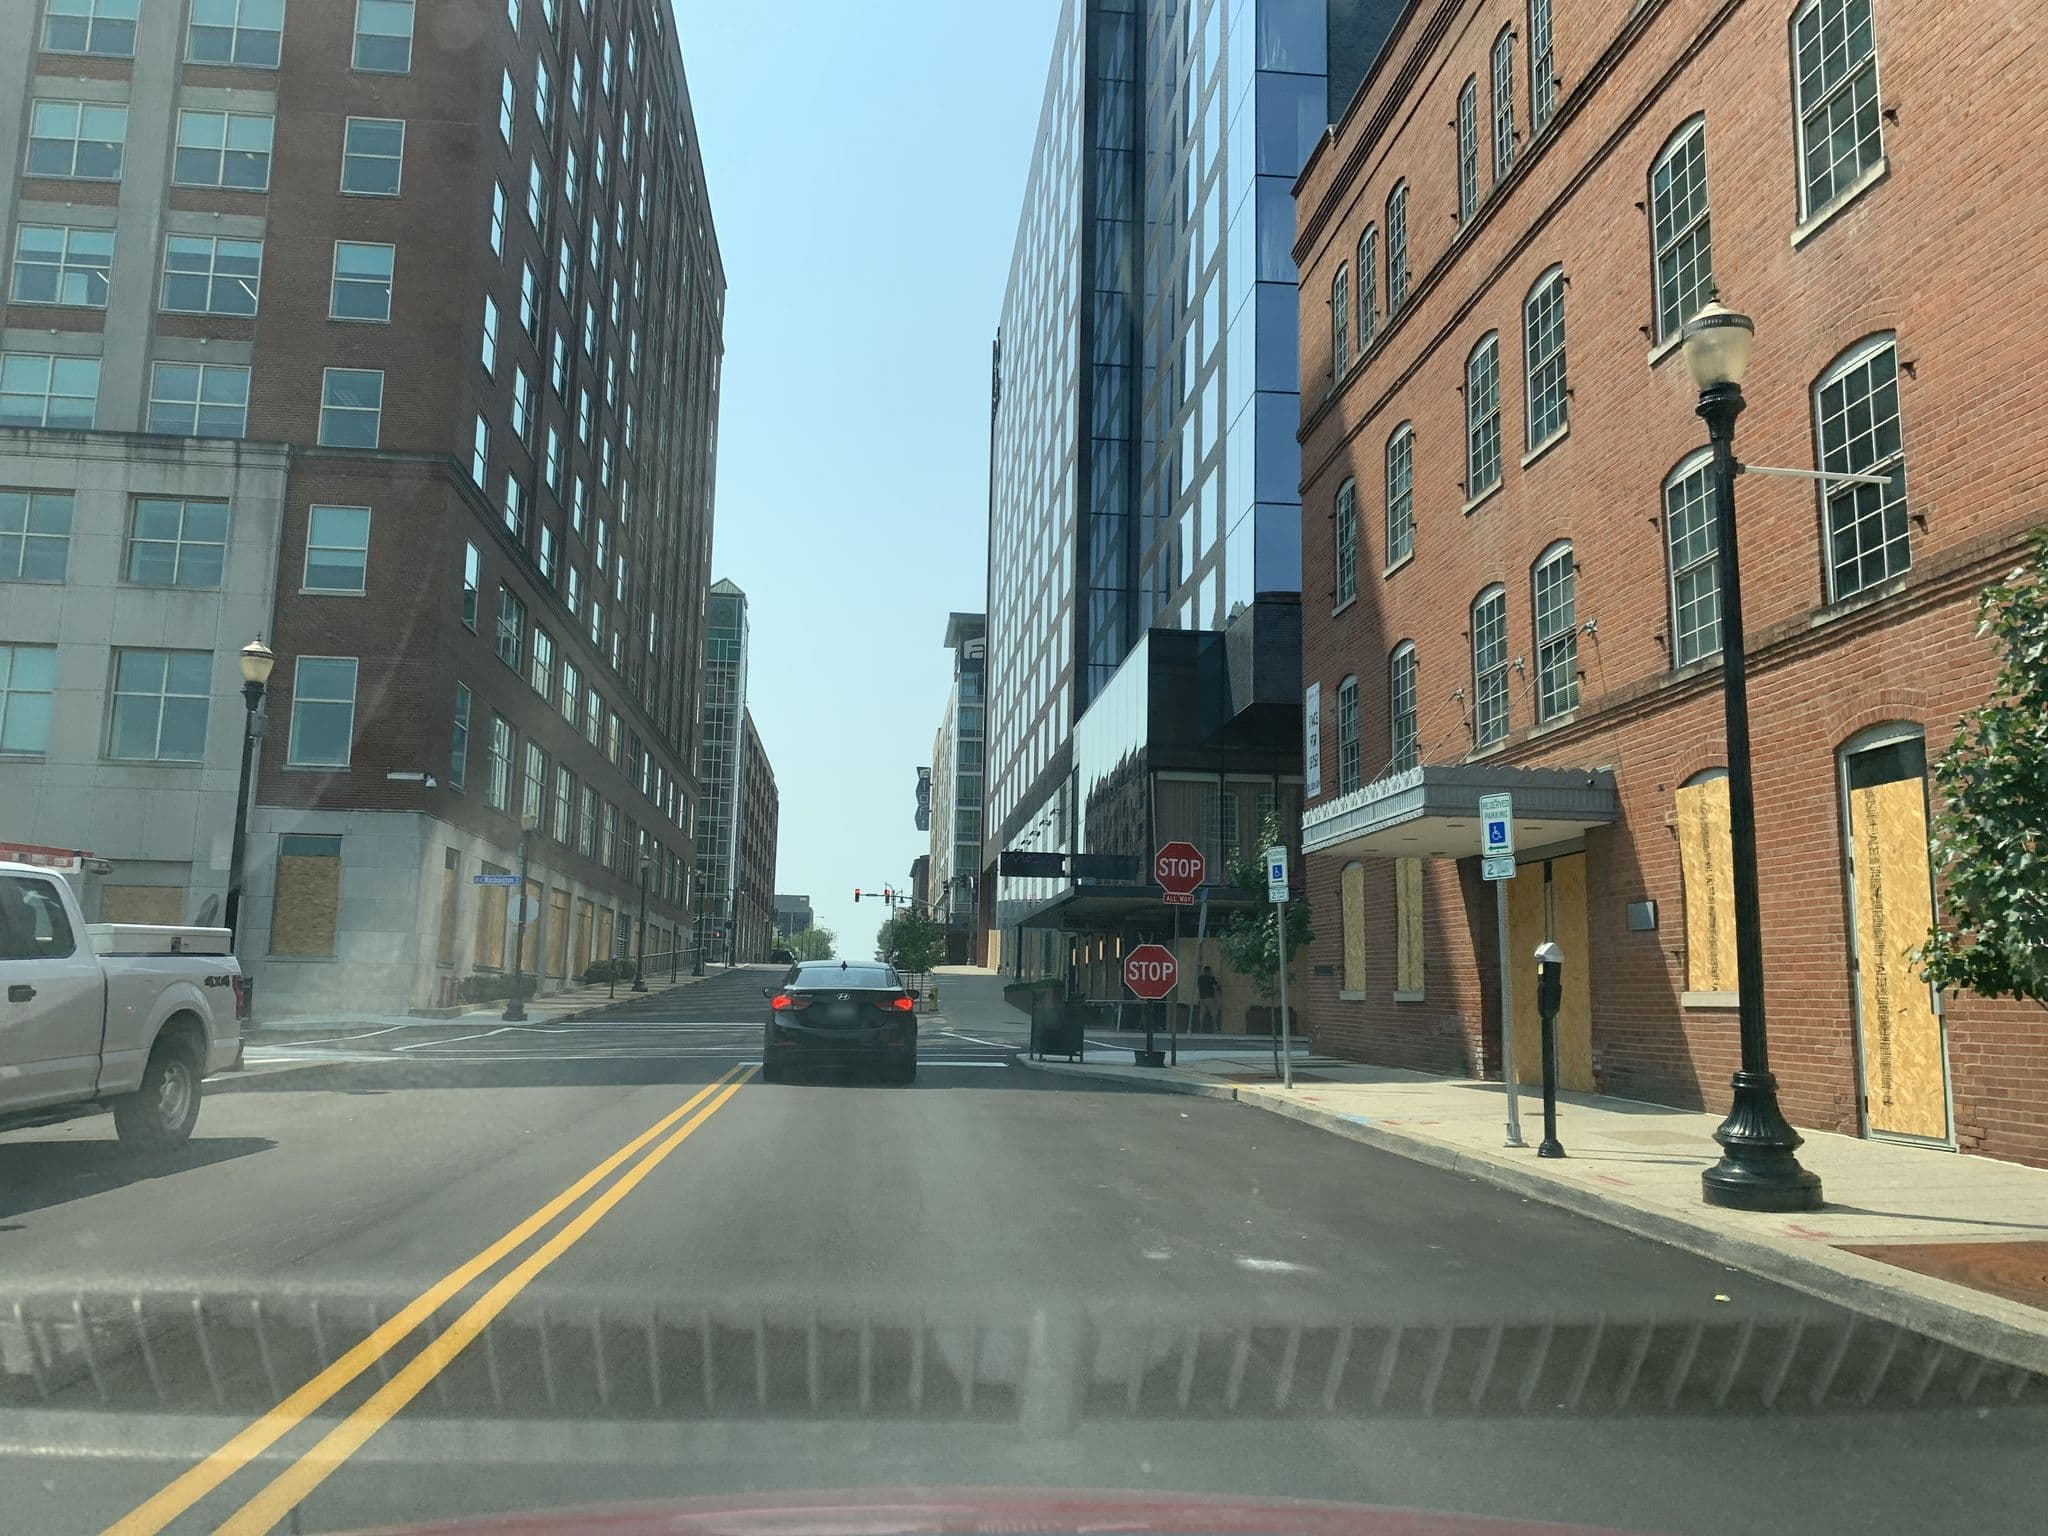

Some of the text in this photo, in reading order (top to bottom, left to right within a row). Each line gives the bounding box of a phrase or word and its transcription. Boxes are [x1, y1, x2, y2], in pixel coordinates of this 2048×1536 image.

[1482, 799, 1509, 809] RESERVED
[1484, 810, 1508, 819] PARKING
[1158, 857, 1201, 878] STOP
[1487, 864, 1494, 875] 2
[1165, 894, 1192, 903] ALL WAY
[1128, 961, 1174, 982] STOP
